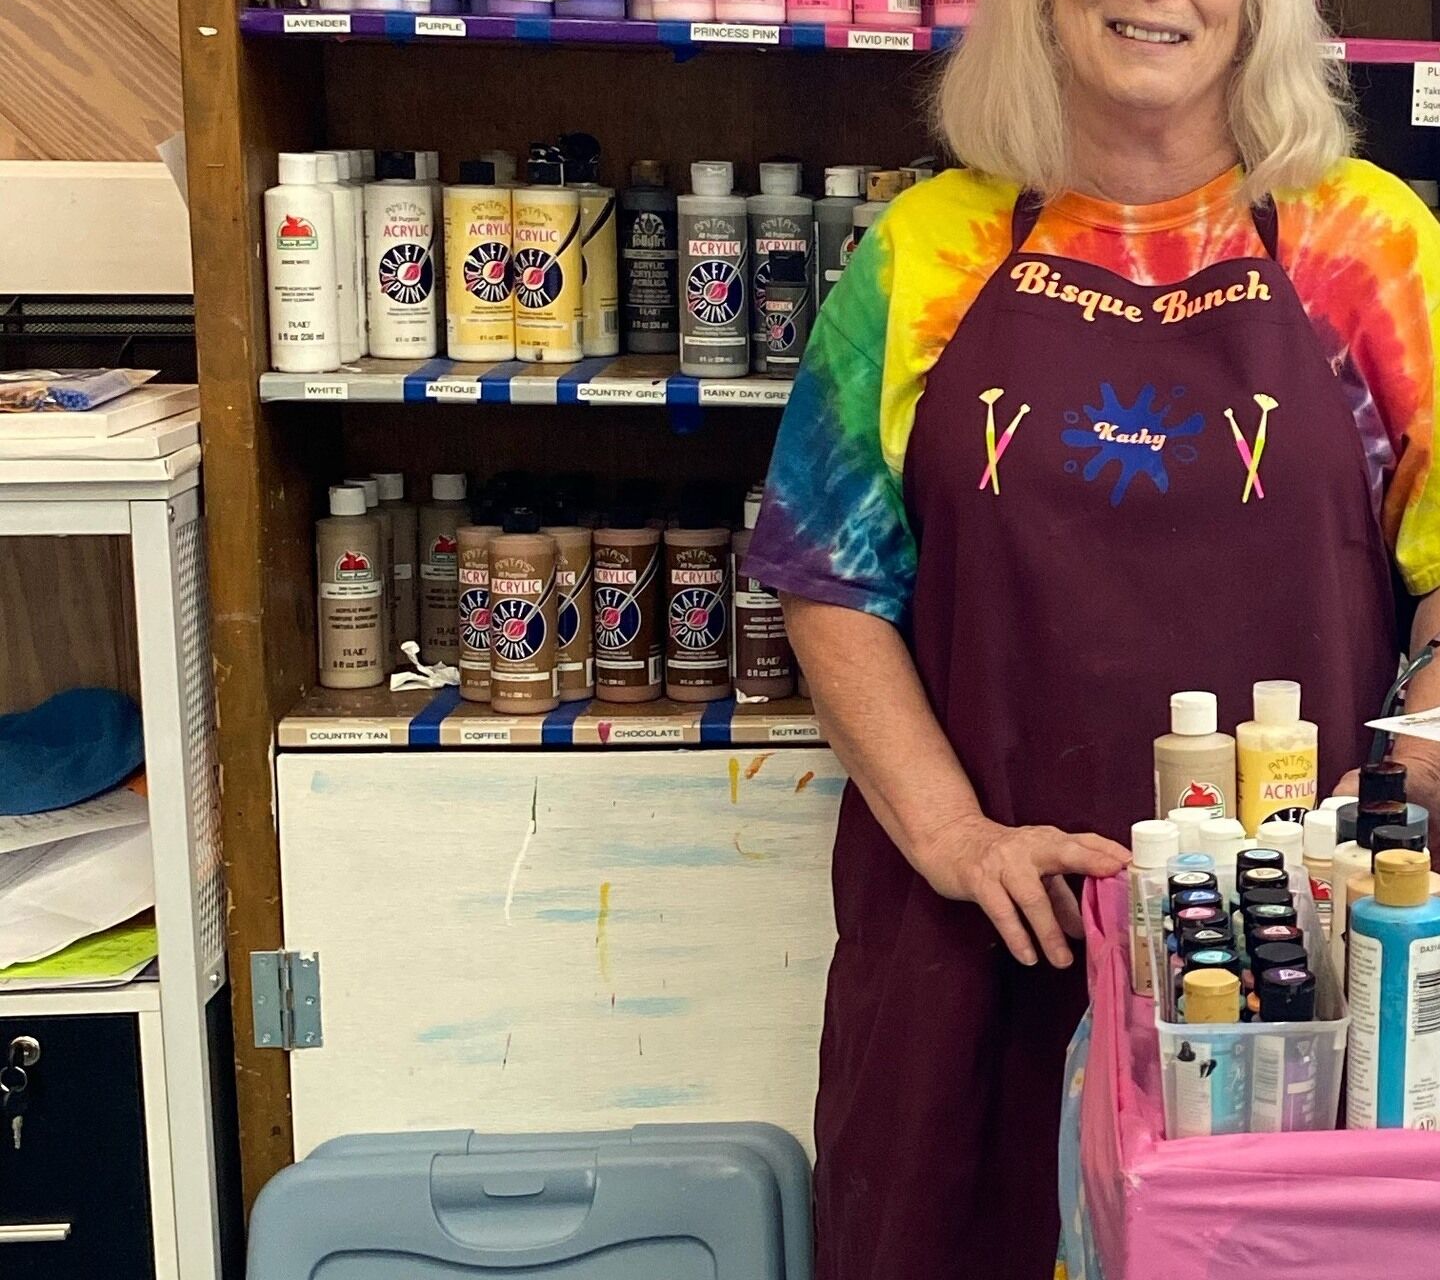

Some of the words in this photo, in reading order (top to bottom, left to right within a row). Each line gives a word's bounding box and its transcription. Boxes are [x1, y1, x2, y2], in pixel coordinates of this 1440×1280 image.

[287, 19, 347, 28] LAVENDER
[418, 22, 462, 31] PURPLE
[693, 27, 750, 38] PRINCESS
[752, 29, 778, 39] PINK
[853, 35, 882, 45] VIVID
[884, 36, 910, 46] PINK
[1423, 115, 1439, 123] Add
[384, 224, 429, 237] ACRYLIC
[470, 224, 511, 236] ACRYLIC
[515, 230, 557, 242] ACRYLIC
[691, 242, 739, 255] ACRYLIC
[1010, 261, 1143, 322] Bisque
[1152, 271, 1271, 324] Bunch
[307, 387, 343, 395] WHITE
[428, 384, 477, 394] ANTIQUE
[579, 388, 632, 397] COUNTRY
[703, 389, 737, 398] RAINY
[740, 389, 762, 399] DAY
[1093, 422, 1167, 451] Kathy
[674, 571, 720, 583] ACRYLIC
[492, 581, 540, 593] ACRYLIC
[677, 626, 713, 648] PAINT
[310, 732, 362, 740] COUNTRY
[366, 732, 388, 740] TAN
[464, 732, 508, 740] COFFEE
[615, 729, 680, 738] CHOCOLATE
[772, 728, 818, 736] NUTMEG
[1264, 780, 1315, 799] ACRYLIC
